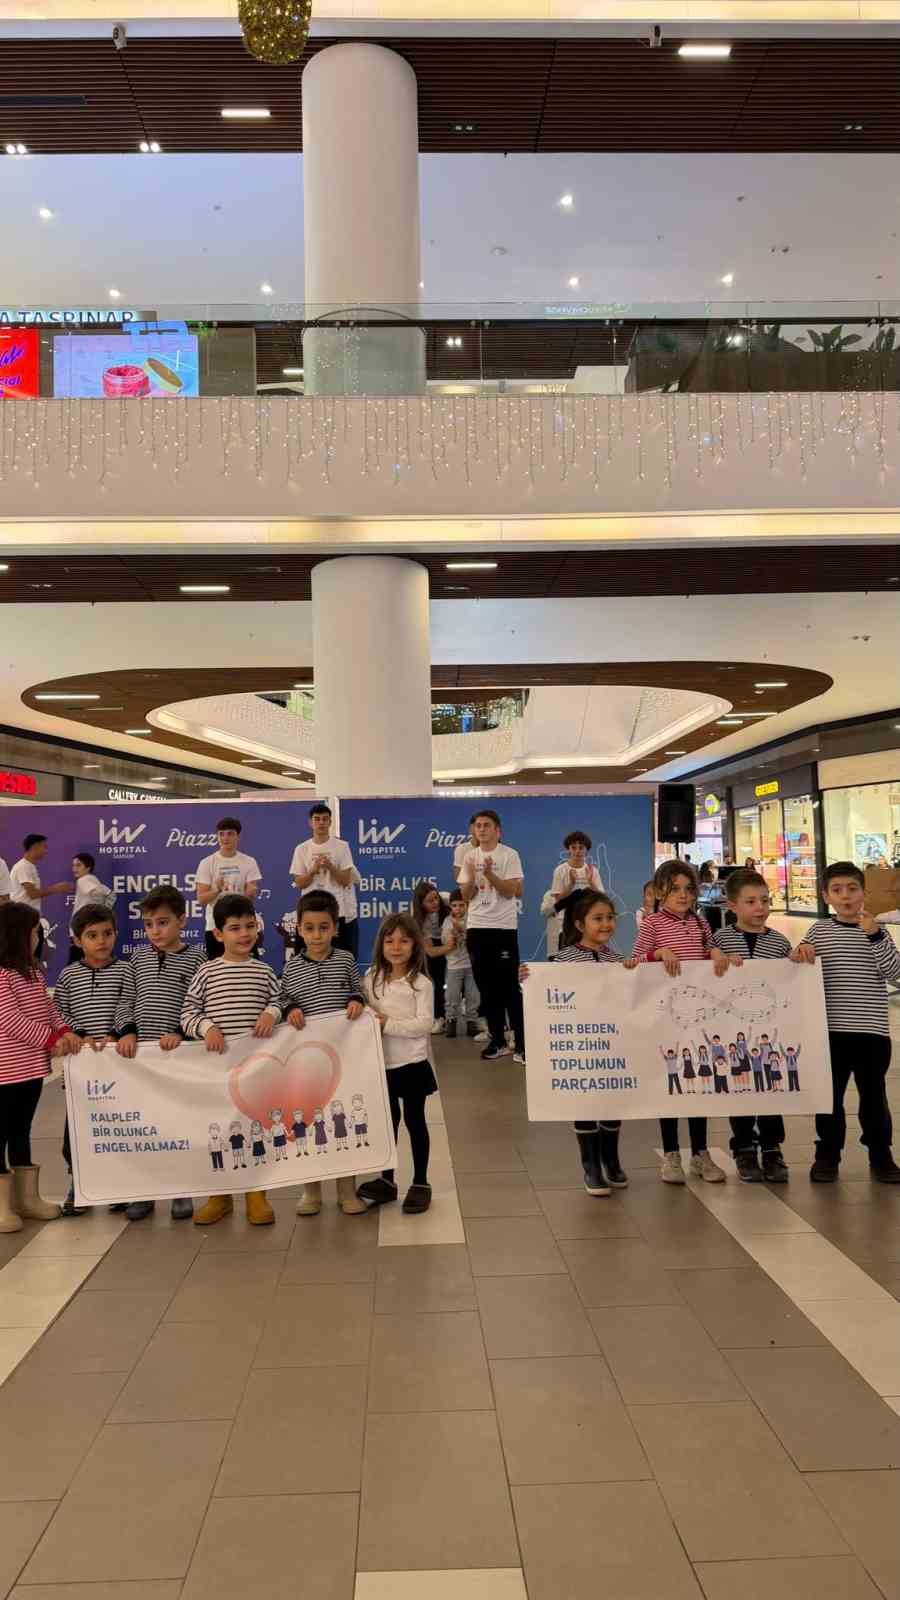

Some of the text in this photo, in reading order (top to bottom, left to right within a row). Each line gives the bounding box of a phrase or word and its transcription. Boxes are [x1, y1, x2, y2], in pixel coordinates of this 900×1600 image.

[166, 828, 219, 847] Piazz
[99, 846, 148, 854] HOSPITAL
[359, 846, 407, 855] HOSPITAL
[113, 874, 197, 894] ENGELS
[360, 875, 385, 891] BİR
[360, 897, 392, 918] BİN
[549, 1023, 620, 1036] HER BEDEN,
[550, 1037, 611, 1052] HER ZİHİN
[550, 1058, 626, 1071] TOPLUMUN
[552, 1077, 638, 1093] PARÇASIDIR!
[91, 1111, 141, 1123] KALPLER
[93, 1125, 157, 1138] BİR OLUNCA
[95, 1139, 190, 1154] ENGEL KALMAZ!
